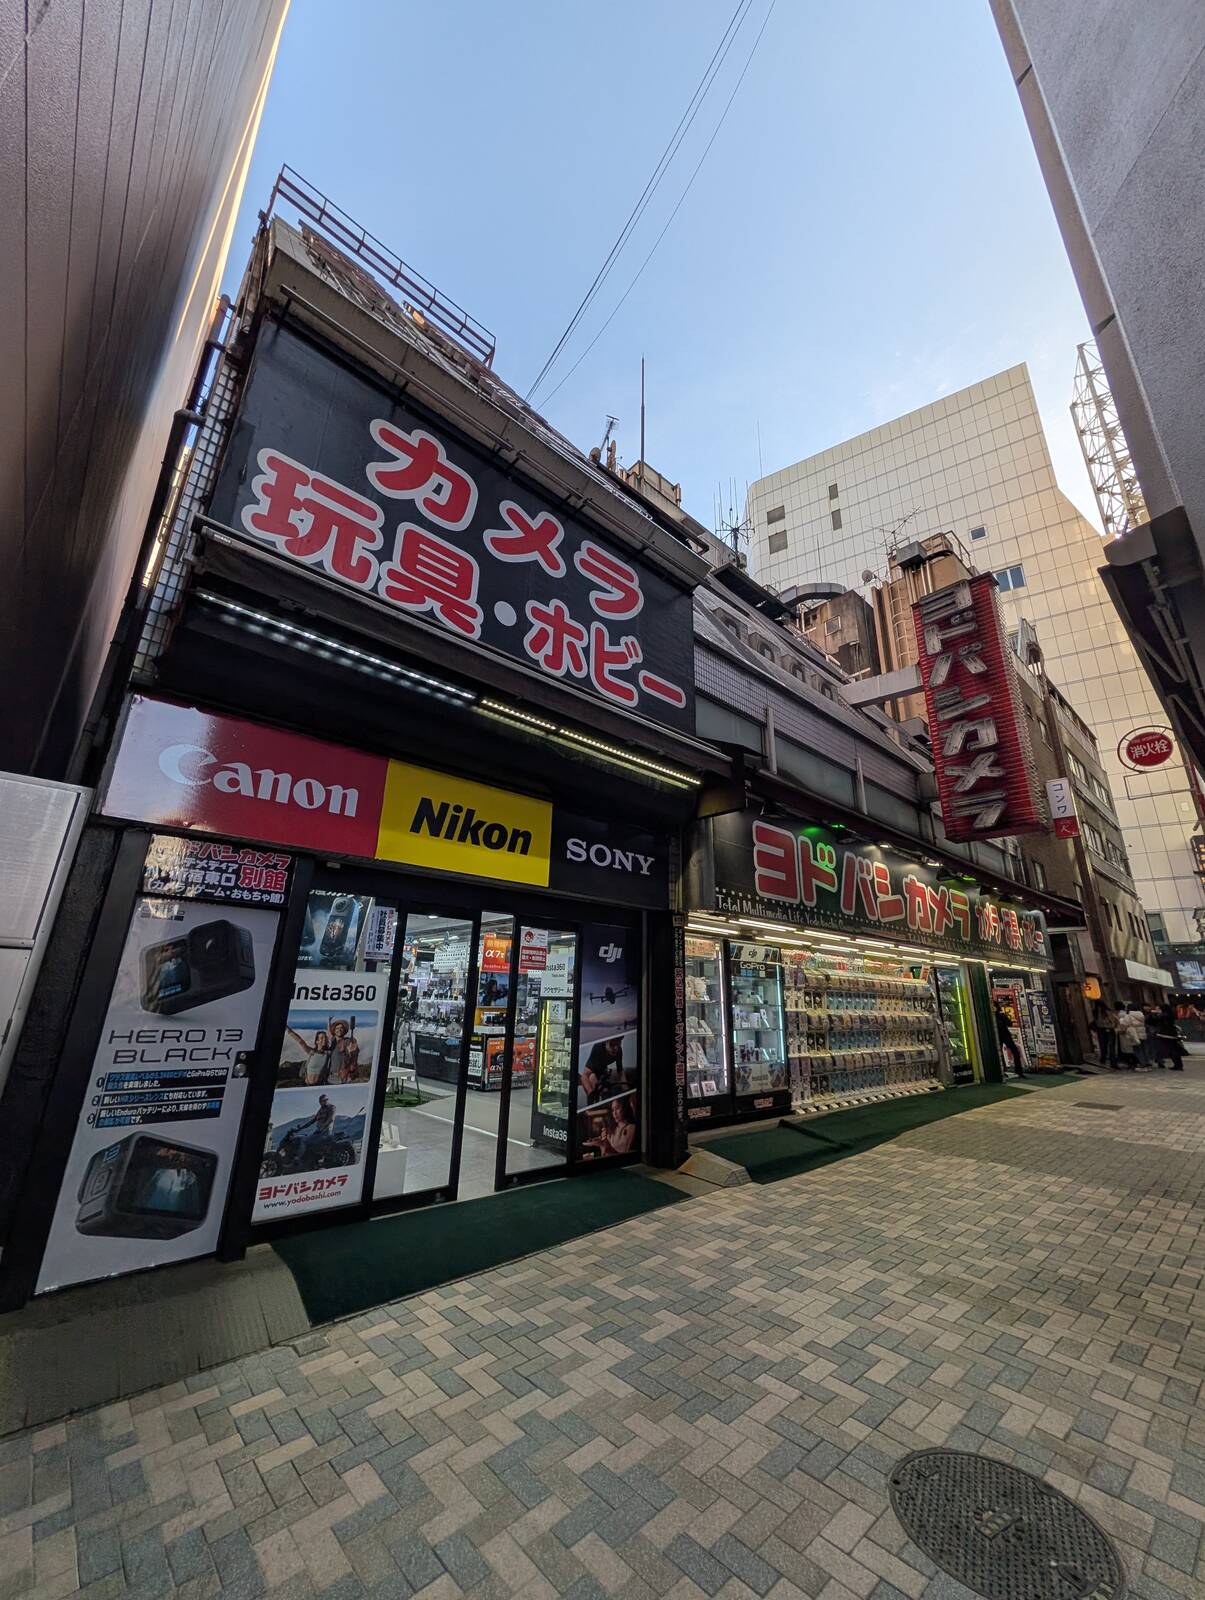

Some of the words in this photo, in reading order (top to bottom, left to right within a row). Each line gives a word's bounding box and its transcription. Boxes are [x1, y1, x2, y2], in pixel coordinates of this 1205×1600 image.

[366, 419, 644, 620] カメラ
[241, 448, 686, 708] 玩具・ホビー
[919, 579, 1008, 829] ヨドバシカメラ
[1130, 739, 1169, 759] 消火栓
[158, 743, 360, 818] Canon
[1052, 783, 1067, 814] コンワ
[409, 797, 533, 857] Nikon
[186, 840, 291, 869] ドバシカメラ
[566, 838, 655, 877] SONY
[238, 865, 288, 892] 別館
[752, 820, 970, 941] ヨドバシカメラ
[715, 894, 741, 913] Total
[742, 900, 789, 921] Multimedia
[788, 910, 805, 924] Life
[598, 942, 623, 963] dji
[740, 961, 766, 971] GoPro
[108, 1029, 206, 1044] HERO
[215, 1028, 244, 1043] 13
[112, 1047, 233, 1065] BLACK
[542, 1125, 568, 1142] Insta36
[258, 1174, 349, 1201] ヨドバシカメラ
[263, 1190, 342, 1209] www.yodobashi.com
